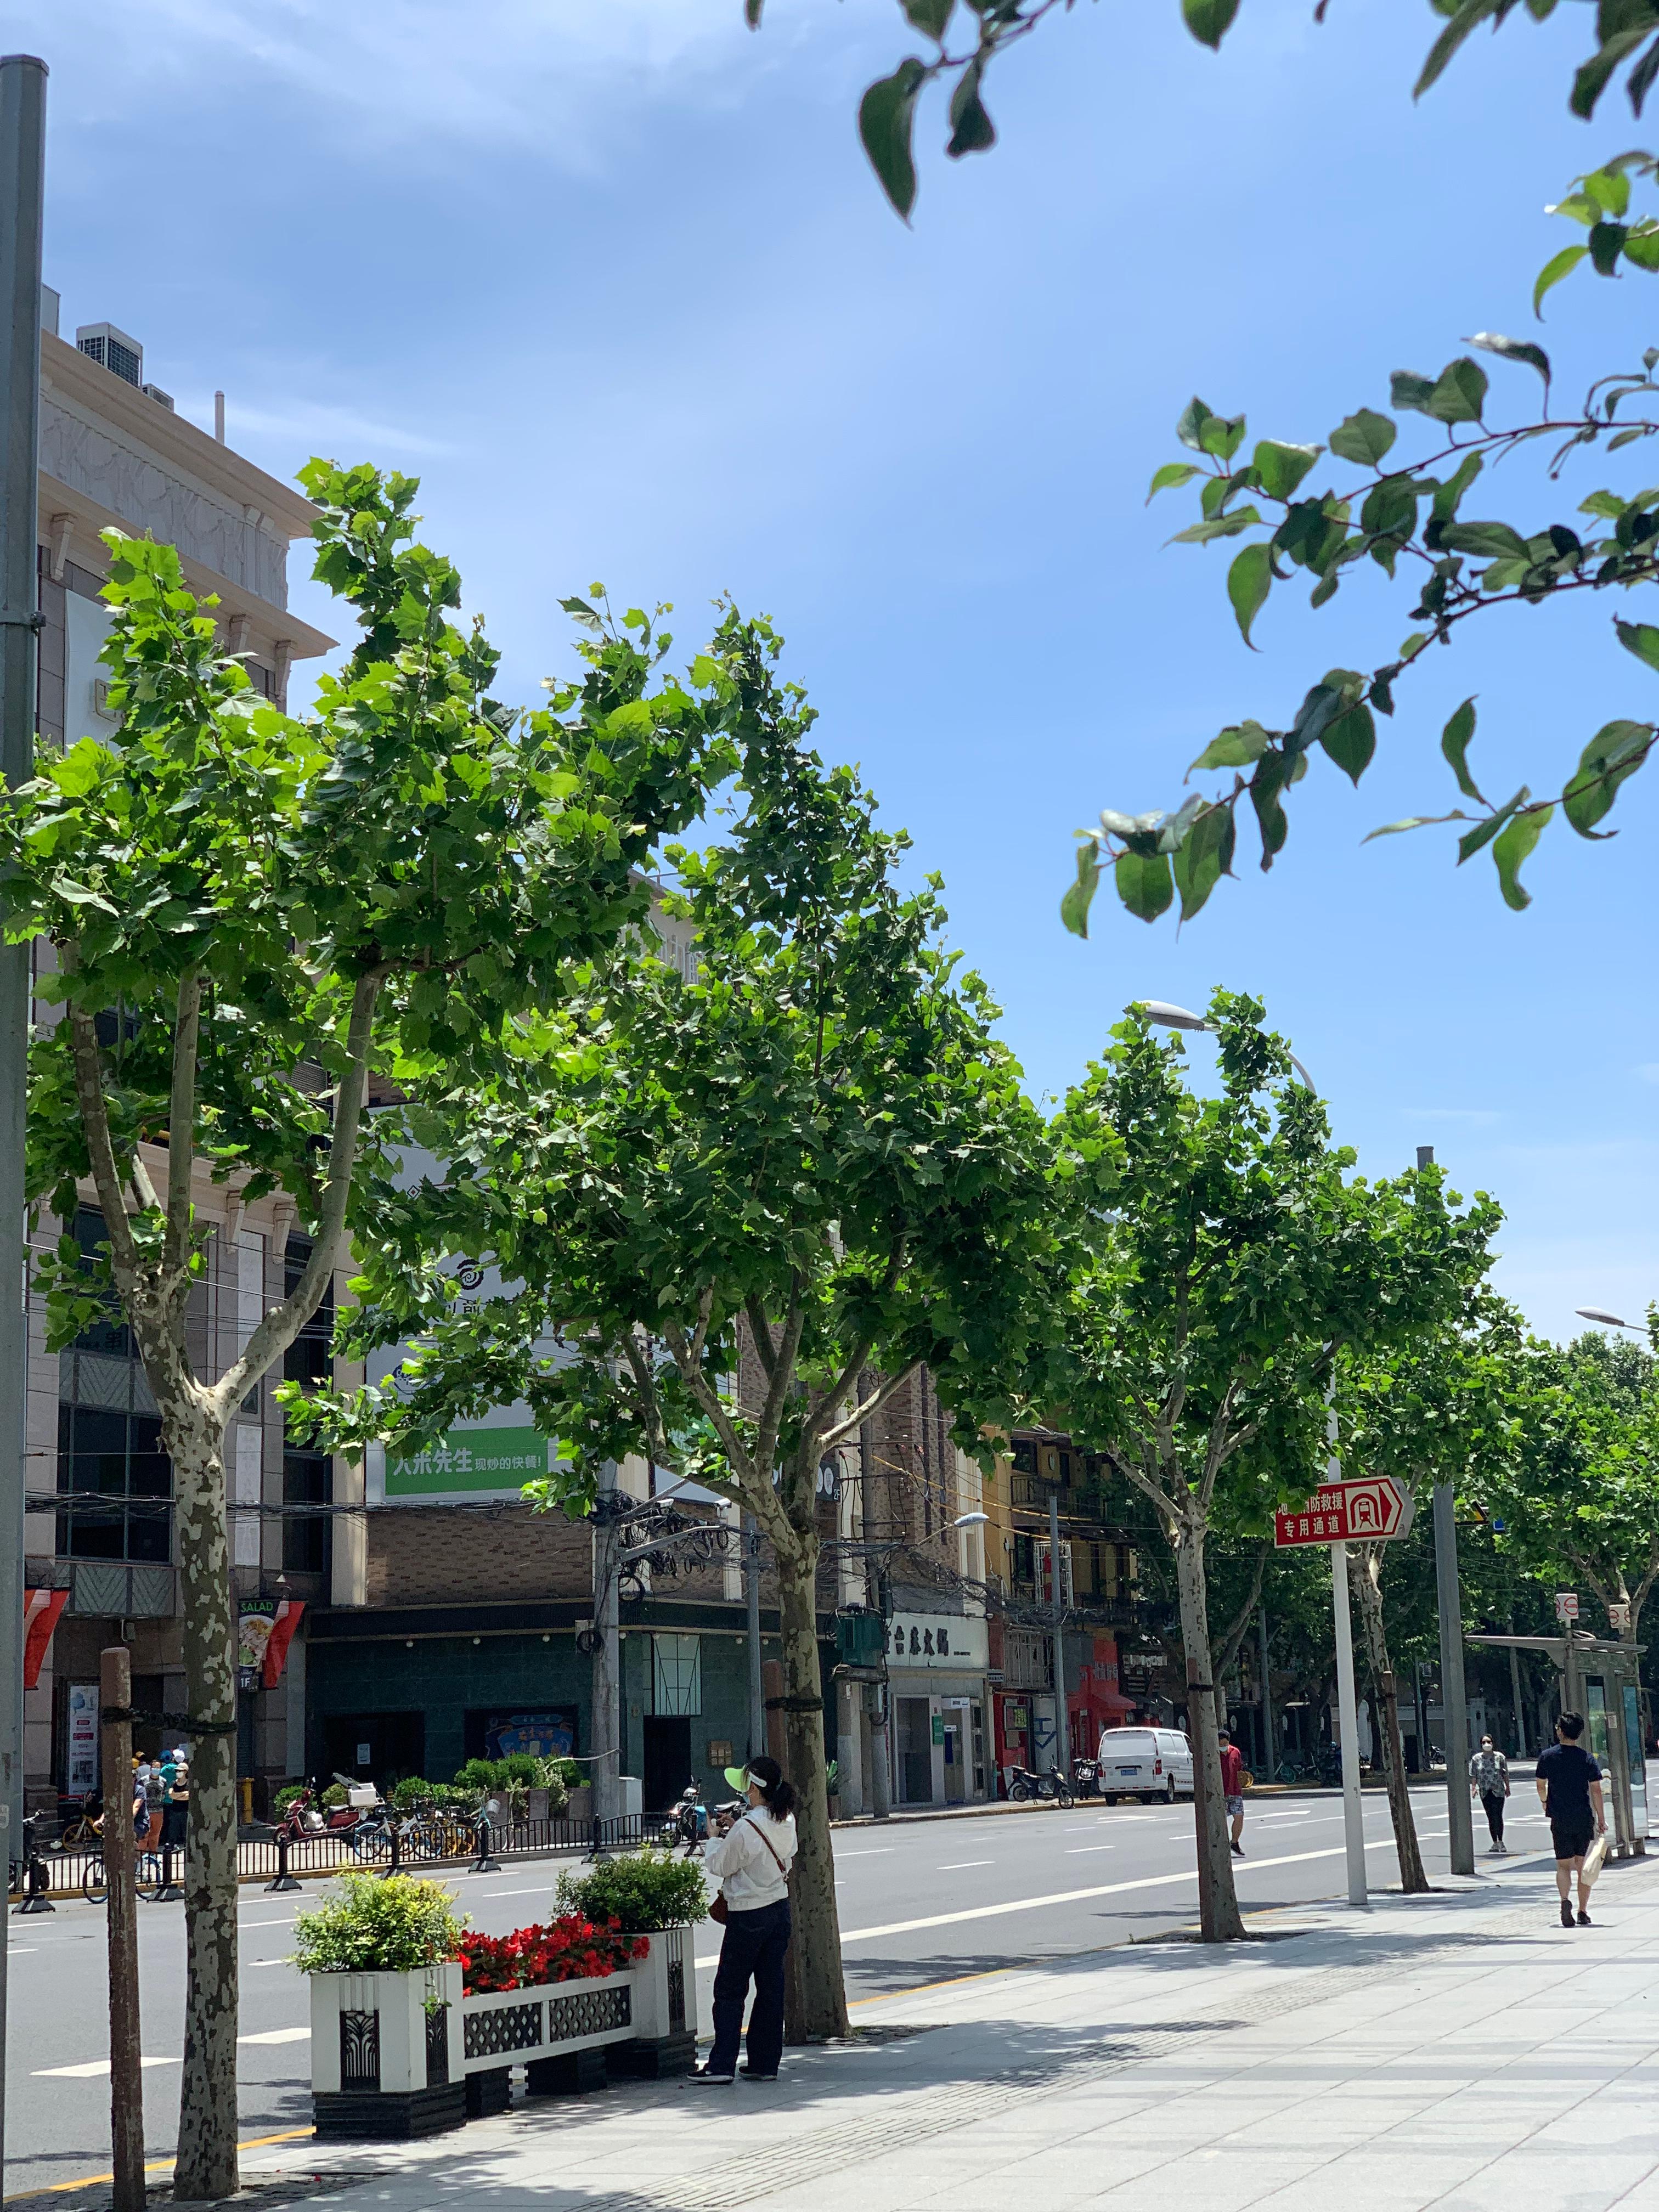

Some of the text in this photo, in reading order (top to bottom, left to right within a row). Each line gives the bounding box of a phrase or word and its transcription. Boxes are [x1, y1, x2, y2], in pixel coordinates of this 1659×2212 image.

[1278, 1491, 1343, 1516] 地防救援
[1284, 1515, 1339, 1538] 专用通道
[241, 1602, 273, 1613] SALAD
[241, 1677, 250, 1688] 1F
